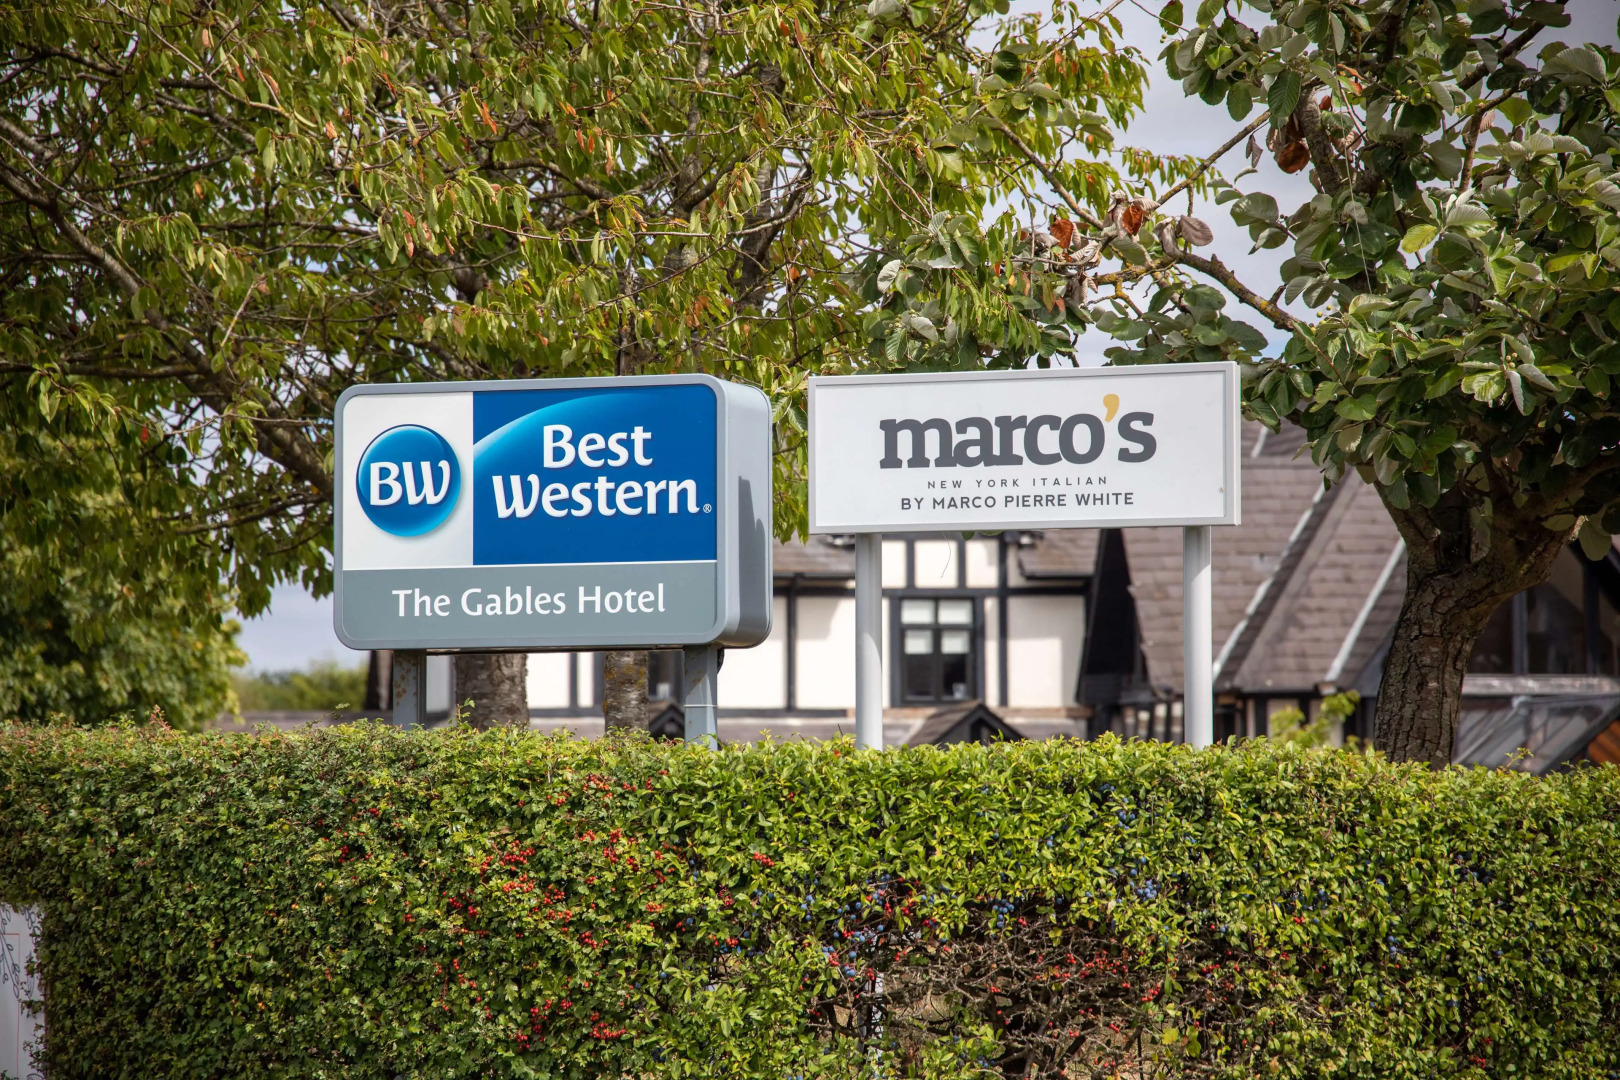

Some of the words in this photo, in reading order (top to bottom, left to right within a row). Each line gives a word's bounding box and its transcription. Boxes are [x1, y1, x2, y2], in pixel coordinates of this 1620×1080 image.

[542, 424, 653, 469] Best
[878, 393, 1157, 470] marco's
[369, 459, 451, 506] BW
[900, 497, 924, 511] BY
[932, 495, 997, 510] MARCO
[1004, 493, 1067, 509] PIERRE
[1075, 492, 1134, 507] WHITE
[927, 479, 964, 490] NEW
[975, 478, 1020, 489] YORK
[1032, 475, 1108, 487] ITALIAN
[391, 587, 451, 617] The
[461, 585, 567, 616] Gables
[578, 583, 666, 614] Hotel
